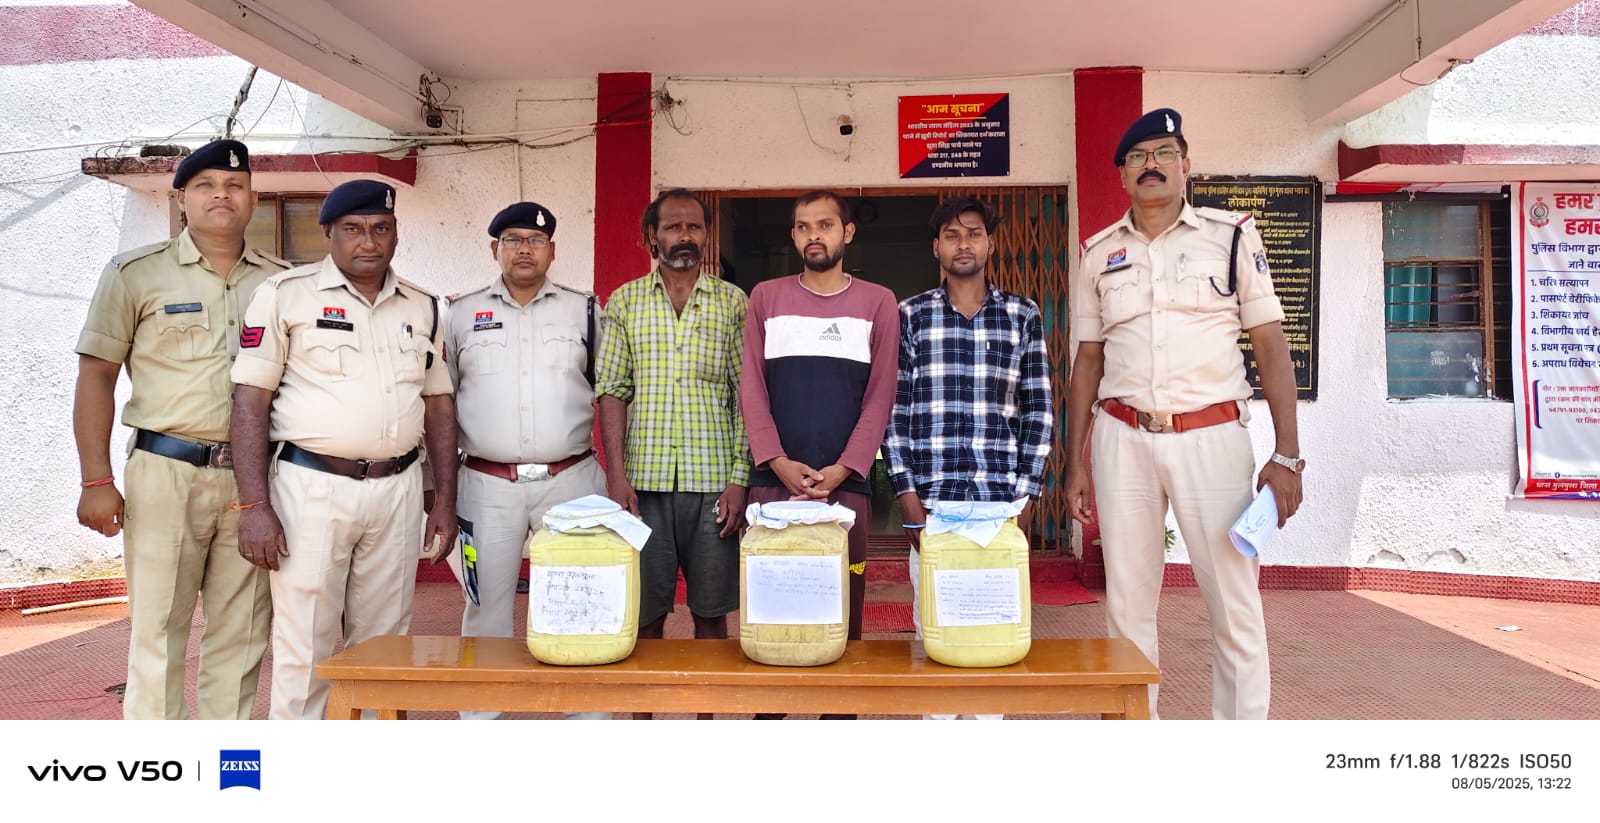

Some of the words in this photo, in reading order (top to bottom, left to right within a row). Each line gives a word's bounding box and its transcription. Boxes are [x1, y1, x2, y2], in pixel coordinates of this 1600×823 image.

[950, 103, 985, 116] सूचना"
[1227, 195, 1266, 208] लोकार्पण
[1553, 193, 1595, 210] हमर
[1531, 242, 1556, 255] पुलिस
[1558, 243, 1584, 253] विभाग
[1568, 259, 1584, 269] जाने
[1559, 279, 1589, 288] सत्यापन
[1541, 325, 1574, 336] विभागीय
[1541, 343, 1559, 352] प्रथम
[1560, 343, 1583, 354] सूचना
[1542, 359, 1567, 369] अपराध
